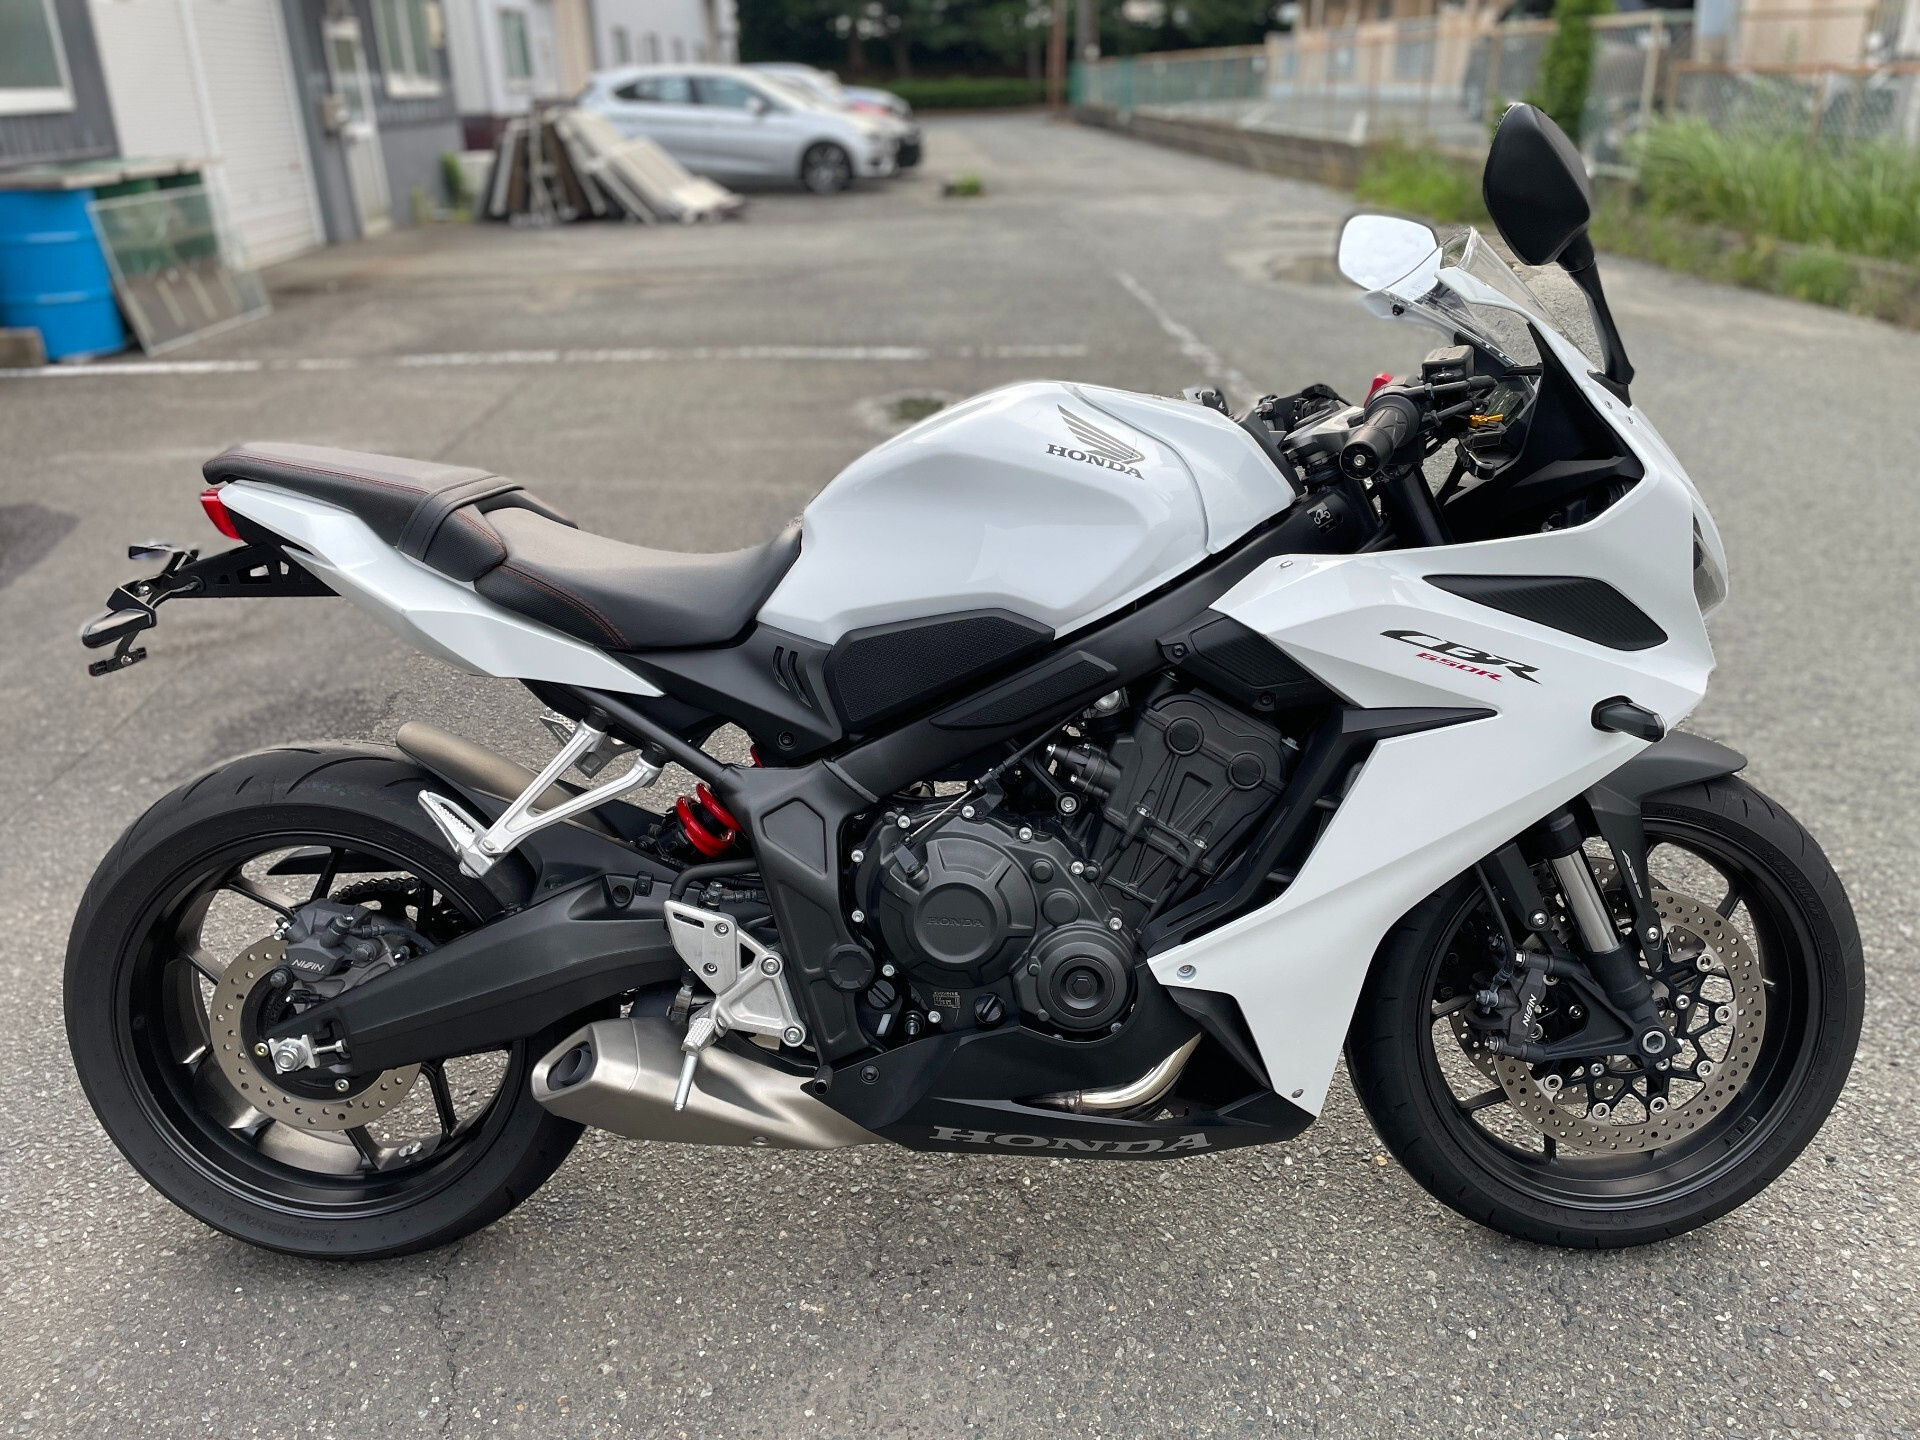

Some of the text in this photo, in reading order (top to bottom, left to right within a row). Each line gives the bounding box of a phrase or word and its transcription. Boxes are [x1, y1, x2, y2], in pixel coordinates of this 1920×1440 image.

[1046, 443, 1145, 481] HONDA
[1379, 629, 1544, 687] CBR
[1415, 651, 1503, 683] 650R
[926, 916, 985, 928] HONDA
[929, 1124, 1213, 1155] HONDA
